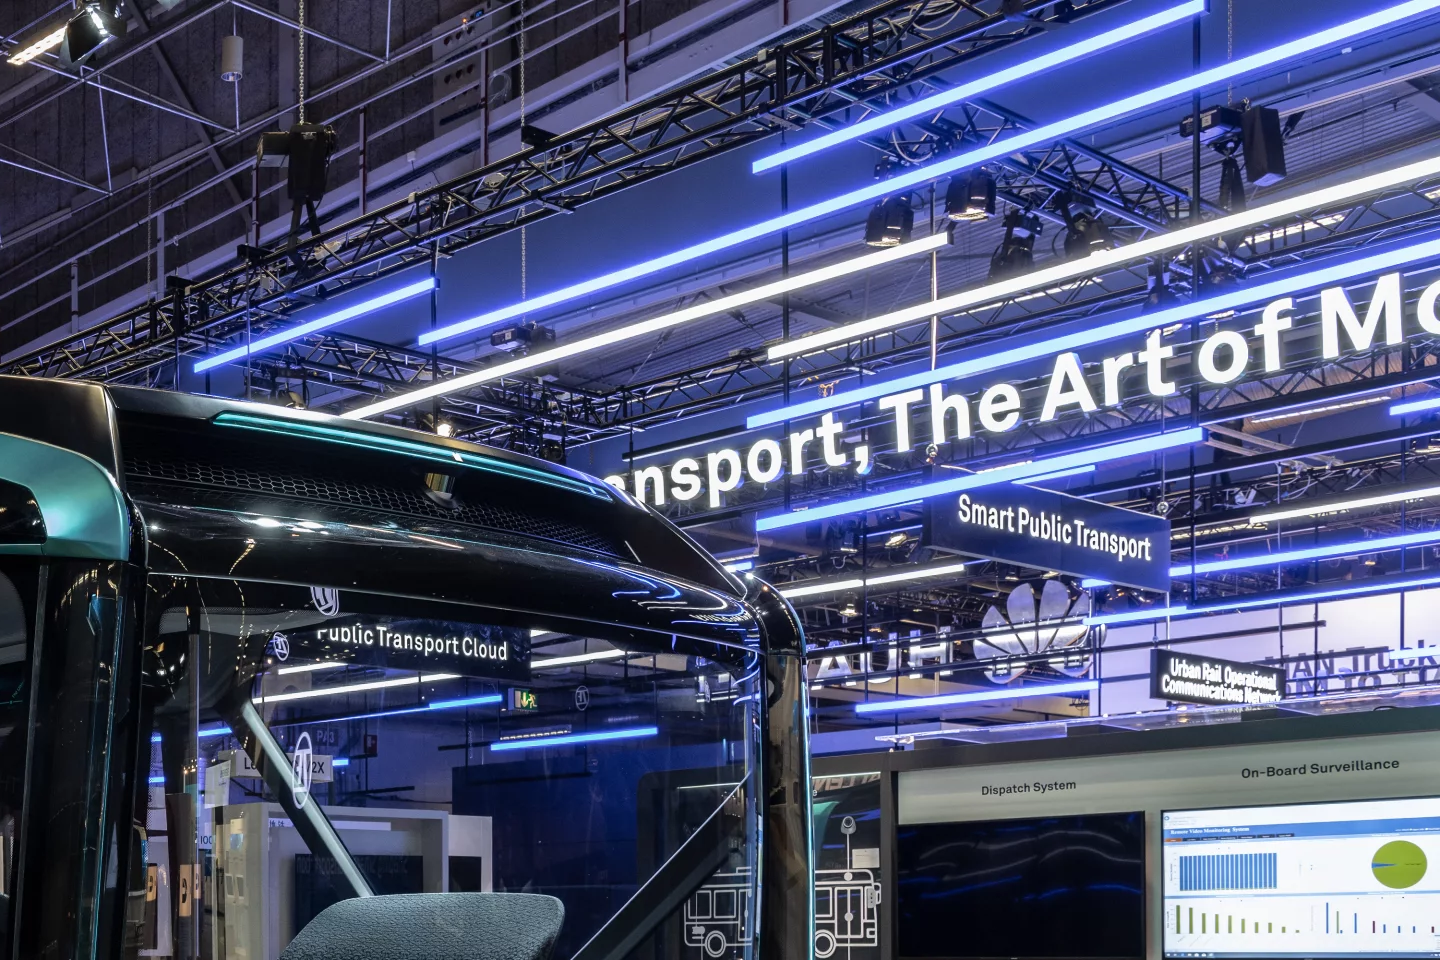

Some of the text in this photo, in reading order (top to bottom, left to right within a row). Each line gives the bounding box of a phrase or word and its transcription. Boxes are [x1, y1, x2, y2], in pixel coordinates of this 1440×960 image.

[879, 382, 1022, 452] The
[1040, 329, 1178, 422] Art
[1198, 297, 1293, 385] of
[958, 493, 1152, 562] Smart Public Transport
[376, 626, 459, 656] Transport
[462, 637, 508, 660] Cloud
[1162, 675, 1244, 703] Communications
[1170, 658, 1277, 691] Urban Rail Operational
[1241, 759, 1400, 779] On-Board Surveillance
[981, 779, 1077, 797] Dispatch System
